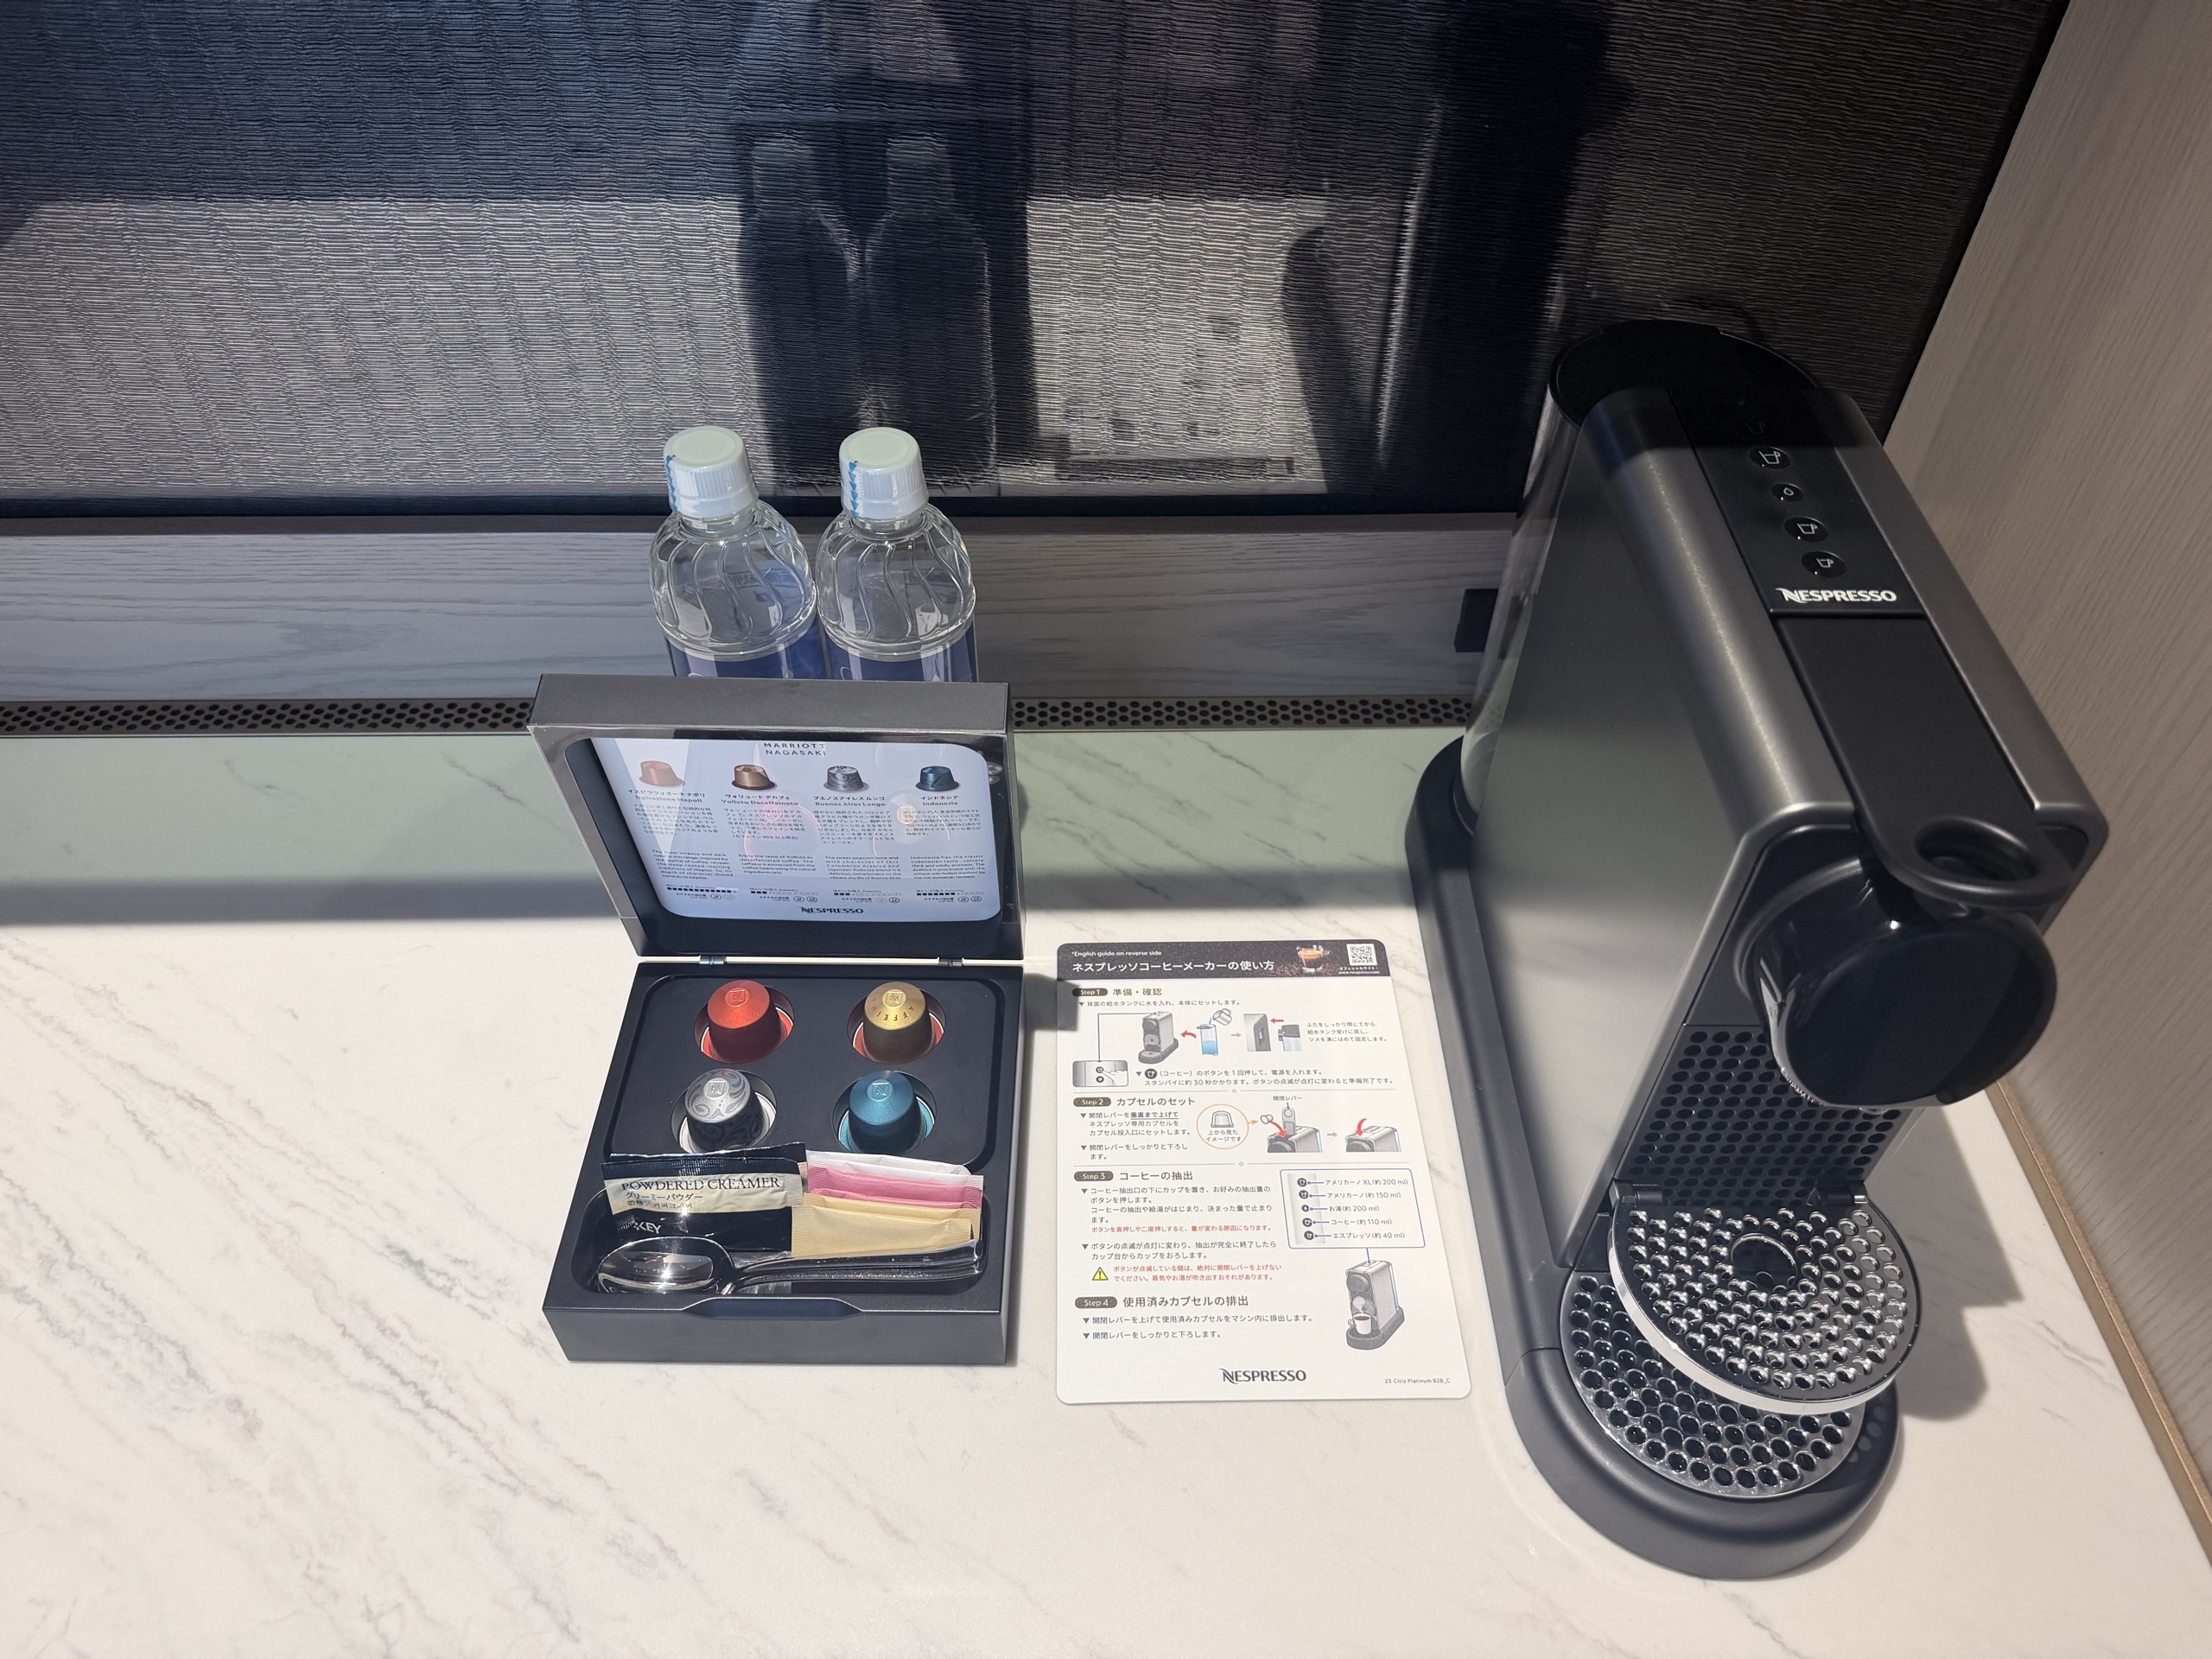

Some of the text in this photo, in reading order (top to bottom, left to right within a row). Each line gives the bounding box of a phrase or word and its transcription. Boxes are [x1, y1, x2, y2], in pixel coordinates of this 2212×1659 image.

[1775, 587, 1897, 604] NESPRESSO
[1072, 960, 1274, 972] ネスプレッソコーヒーメーカーの使い方
[1113, 988, 1162, 996] 準備・確認
[1117, 1097, 1195, 1106] カプセルのセット
[1120, 1171, 1193, 1181] コーヒーの抽出
[622, 1177, 780, 1191] POWDERED CREAMER
[639, 1221, 661, 1234] KEY
[1084, 1298, 1101, 1307] Step
[1123, 1296, 1248, 1308] 使用済みカプセルの排出
[1093, 1330, 1221, 1339] 開閉レバーをしっかりと下ろします。
[1218, 1368, 1306, 1384] NESPRESSO
